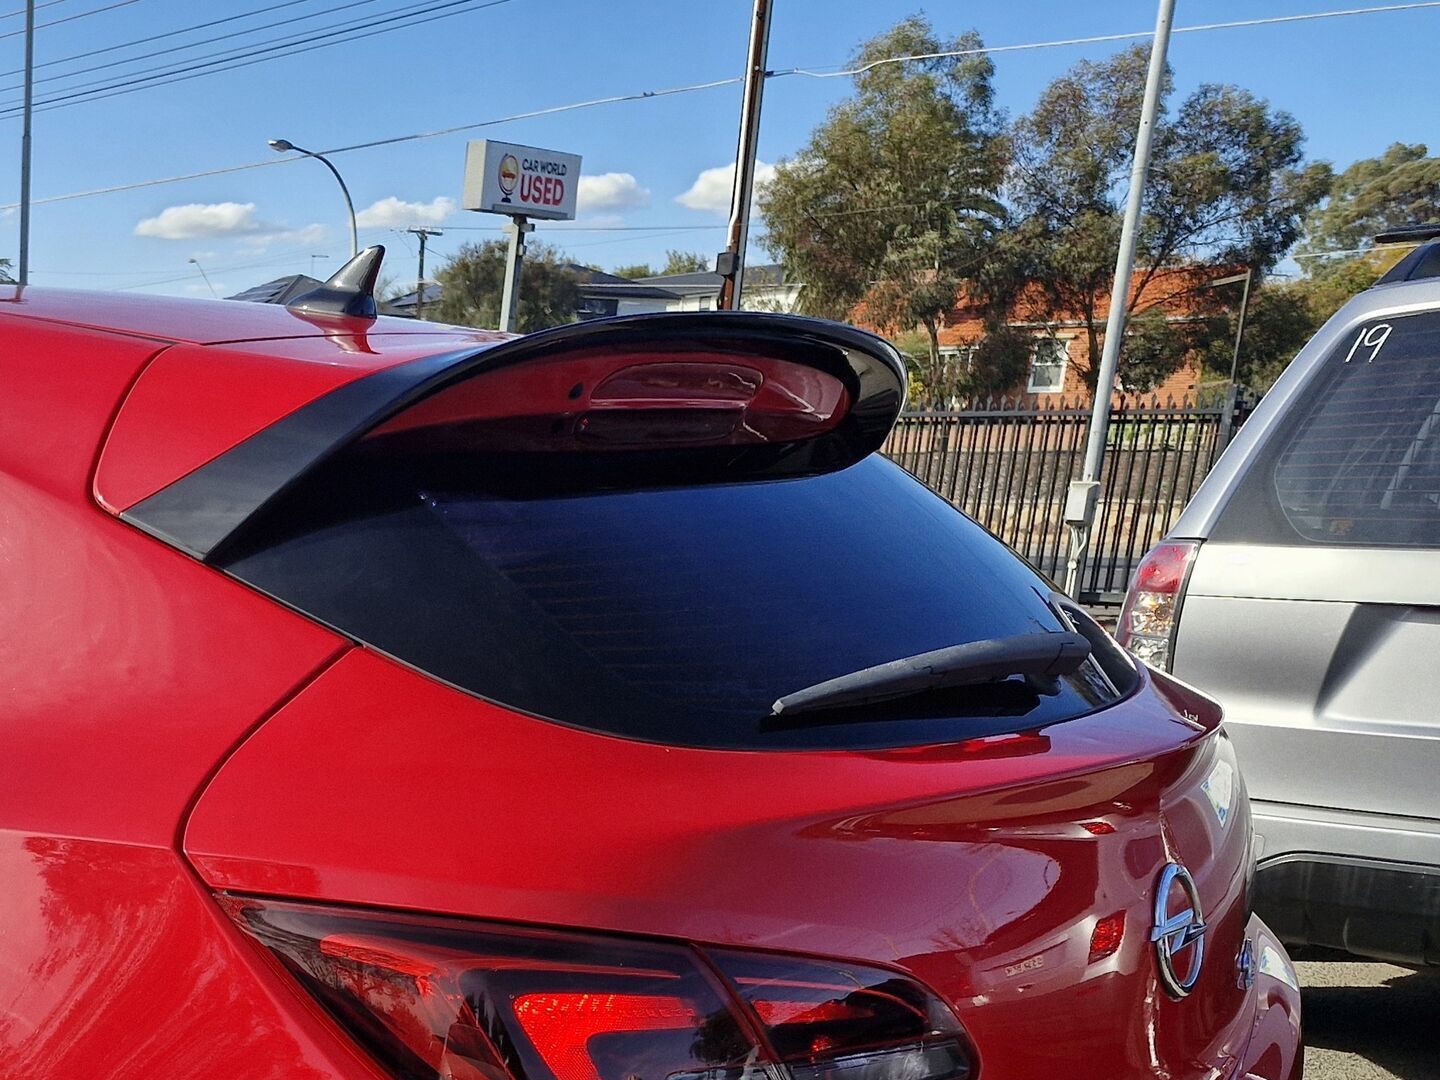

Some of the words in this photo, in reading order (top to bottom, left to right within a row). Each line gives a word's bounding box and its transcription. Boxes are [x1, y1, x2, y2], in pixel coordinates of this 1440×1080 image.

[522, 158, 539, 173] CAR
[540, 163, 568, 177] WORLD
[520, 174, 565, 206] USED
[1345, 323, 1393, 362] 19
